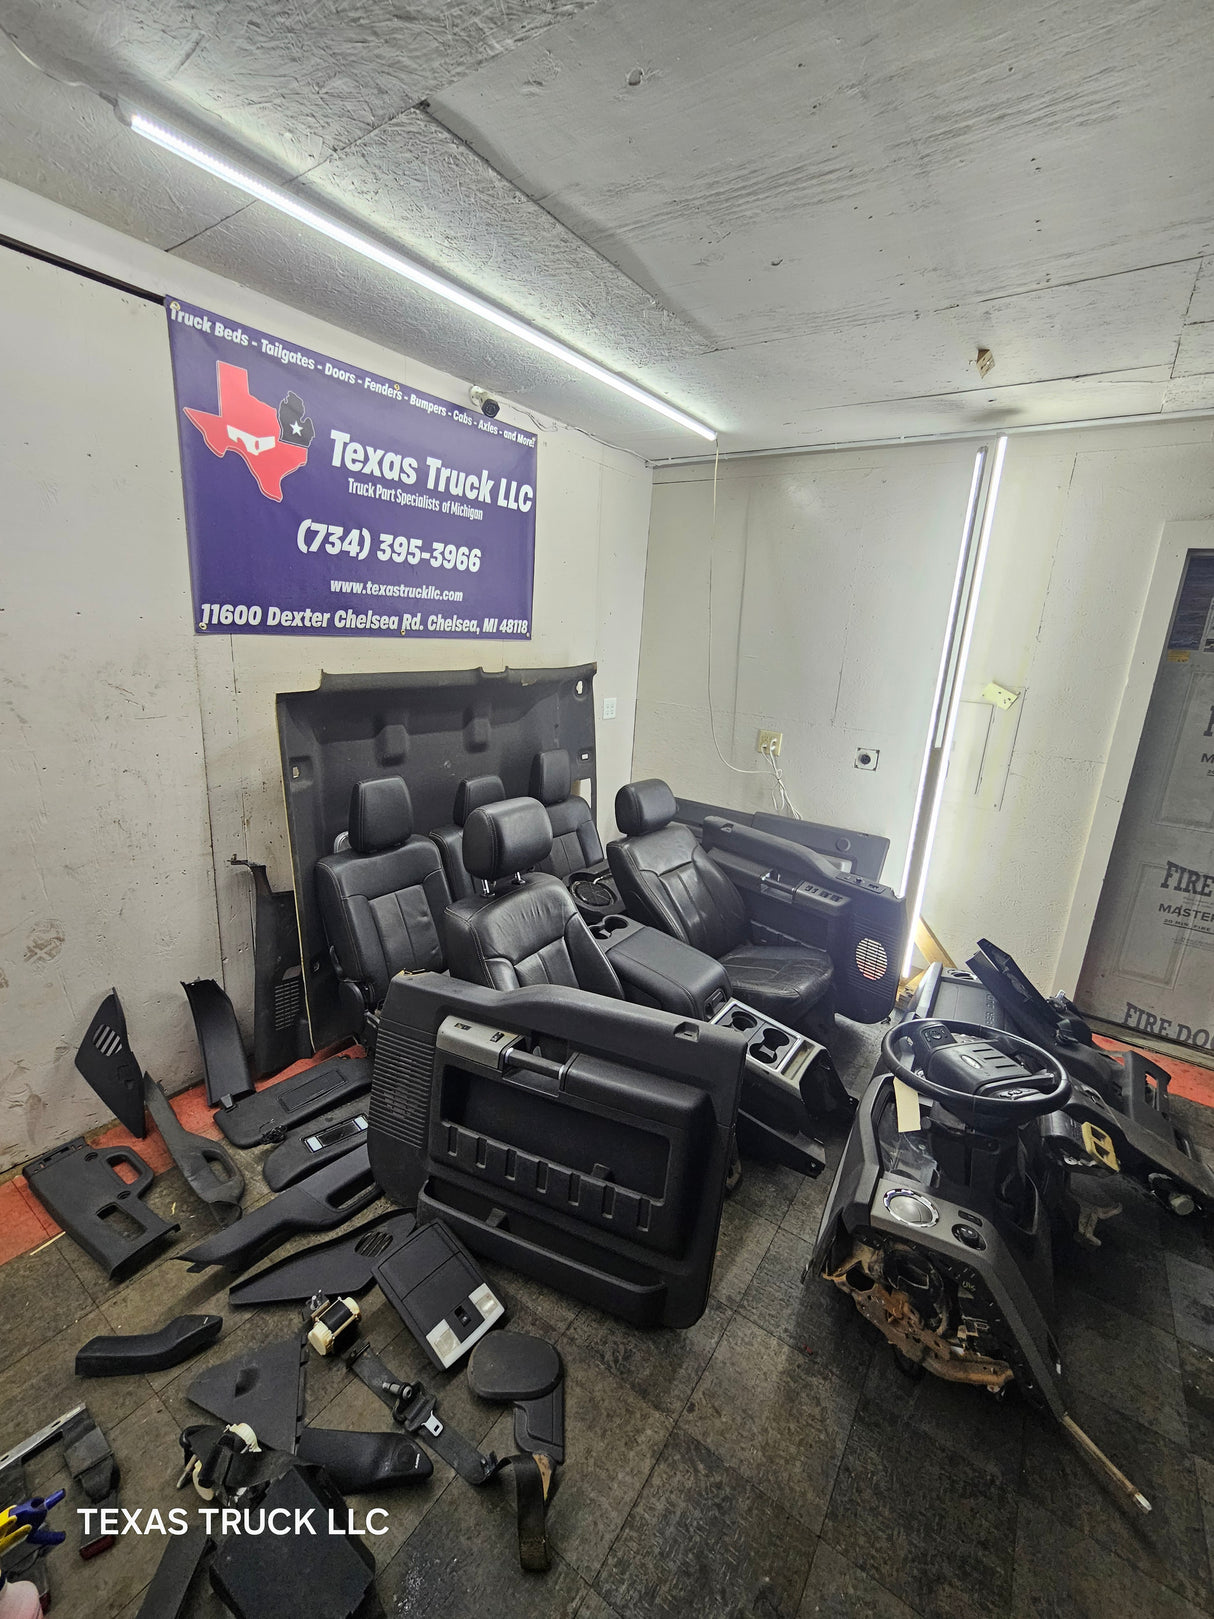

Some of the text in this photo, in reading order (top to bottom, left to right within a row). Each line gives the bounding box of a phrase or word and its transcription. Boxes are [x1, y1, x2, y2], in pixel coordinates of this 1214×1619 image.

[170, 304, 212, 333] Truck
[214, 322, 249, 346] Beds
[261, 339, 315, 369] Tailgates
[325, 362, 356, 384] Doors
[364, 377, 402, 401] Fenders
[410, 394, 446, 416] Bumpers
[453, 410, 472, 426] Cabs
[478, 420, 498, 435] Axles
[504, 430, 516, 441] and
[517, 434, 535, 448] More!
[330, 429, 533, 513] Texas Truck LLC
[348, 477, 483, 521] Truck Part Specialists of Michigan
[297, 518, 482, 573] (734) 395-3966
[330, 580, 463, 602] www.texastruckllc.com
[201, 603, 528, 635] 11600 Dexter Chelsea Rd. Chelsea, MI 48118
[1160, 860, 1214, 898] FIRE
[1158, 903, 1214, 922] MASTE
[1123, 1001, 1172, 1037] FIRE
